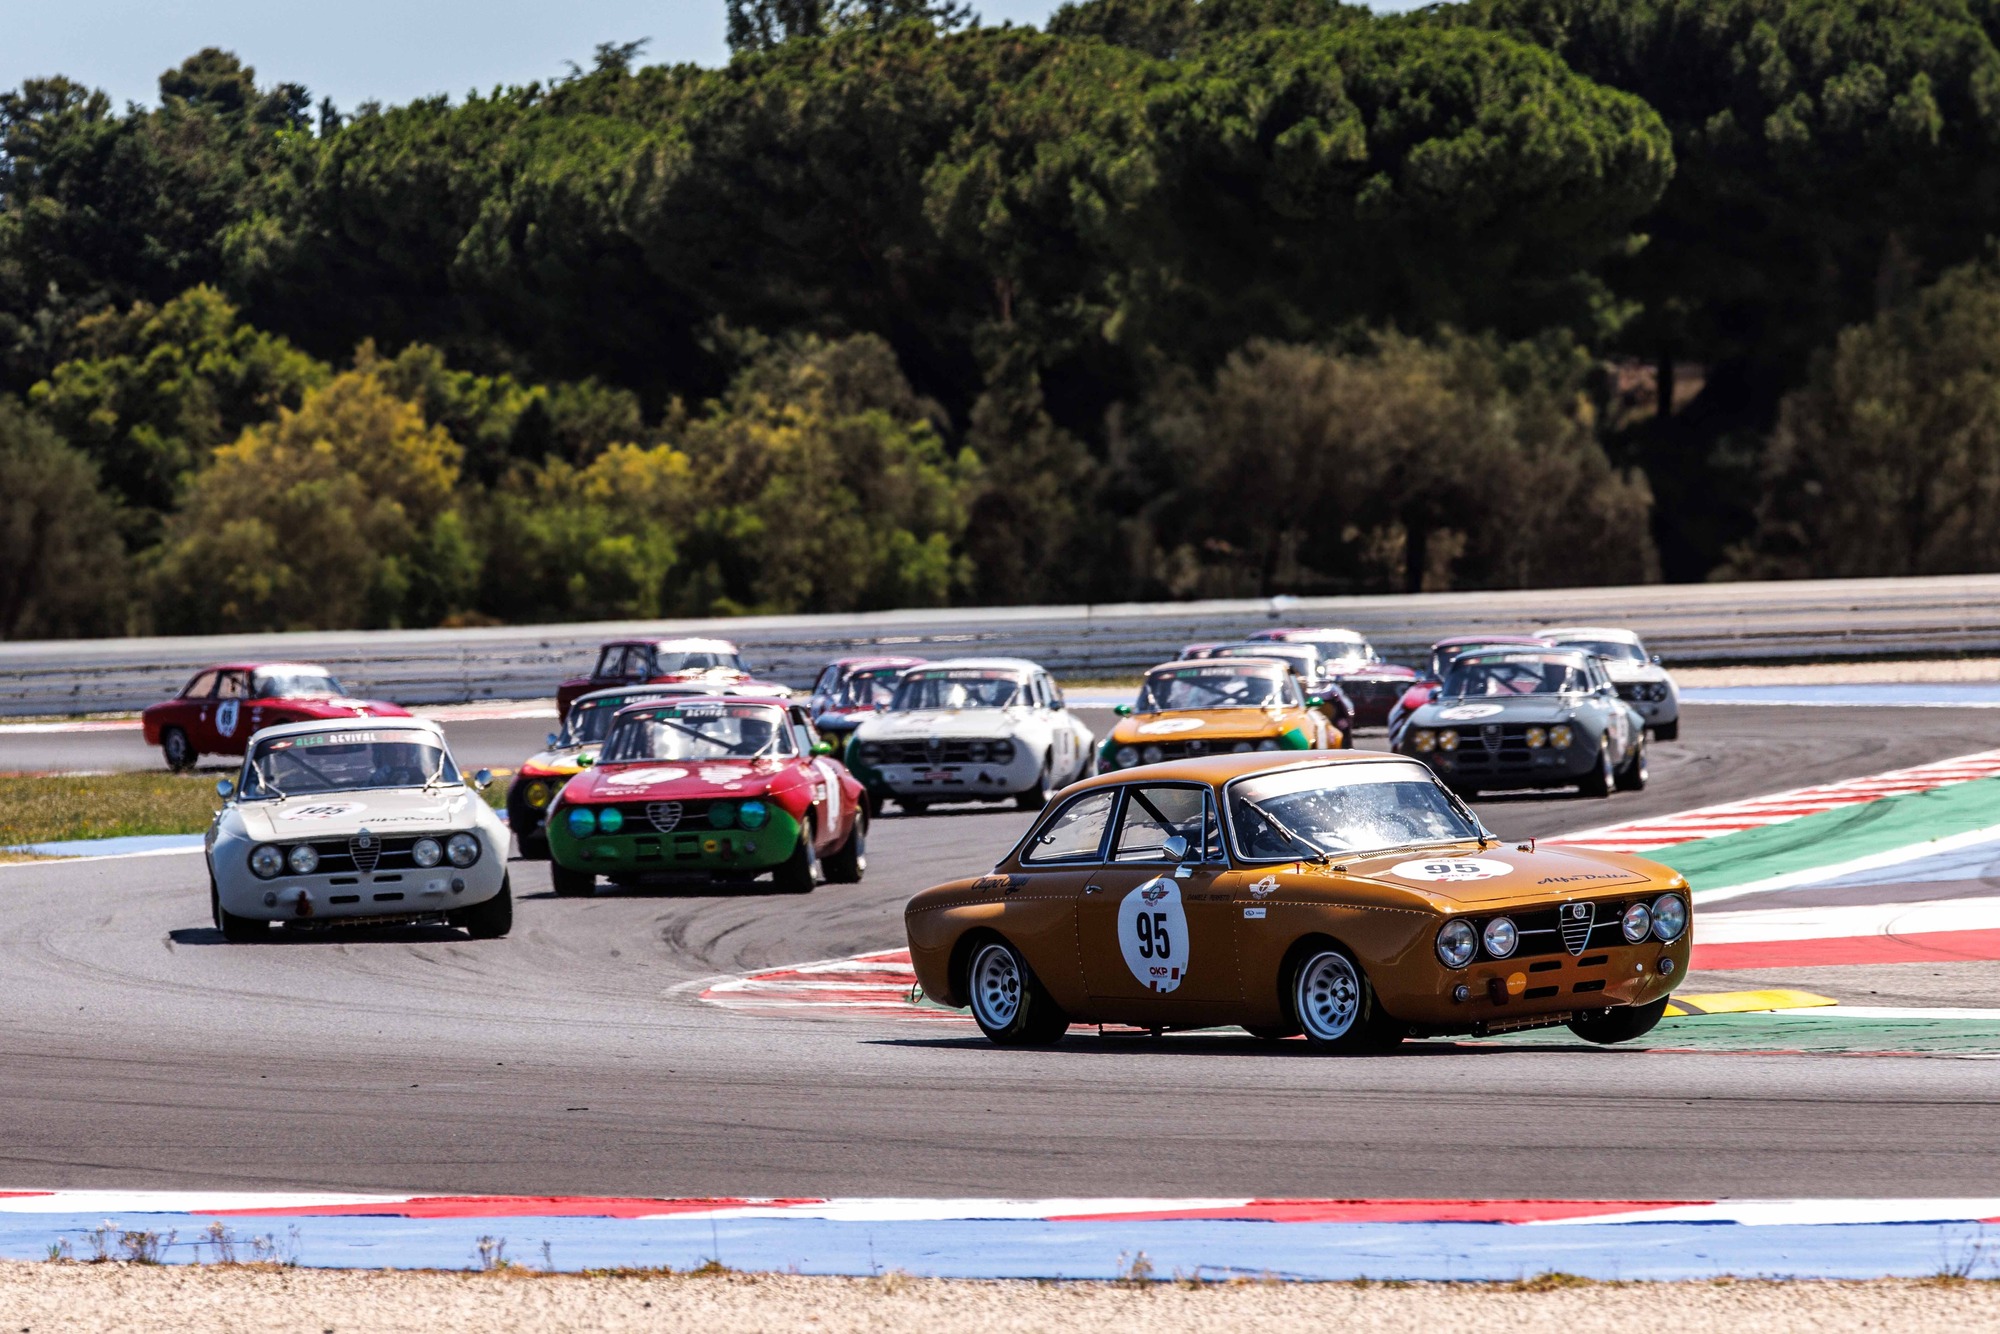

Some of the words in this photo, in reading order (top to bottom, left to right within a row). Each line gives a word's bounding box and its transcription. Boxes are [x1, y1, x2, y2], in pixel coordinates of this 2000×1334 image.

[686, 708, 728, 718] REVIVAL
[295, 736, 324, 747] ALFA
[329, 732, 376, 744] REVIVAL
[296, 805, 353, 816] 105
[1423, 863, 1481, 875] 95
[1537, 876, 1582, 885] Alfa
[1136, 911, 1171, 960] 95
[1149, 966, 1168, 976] OKP
